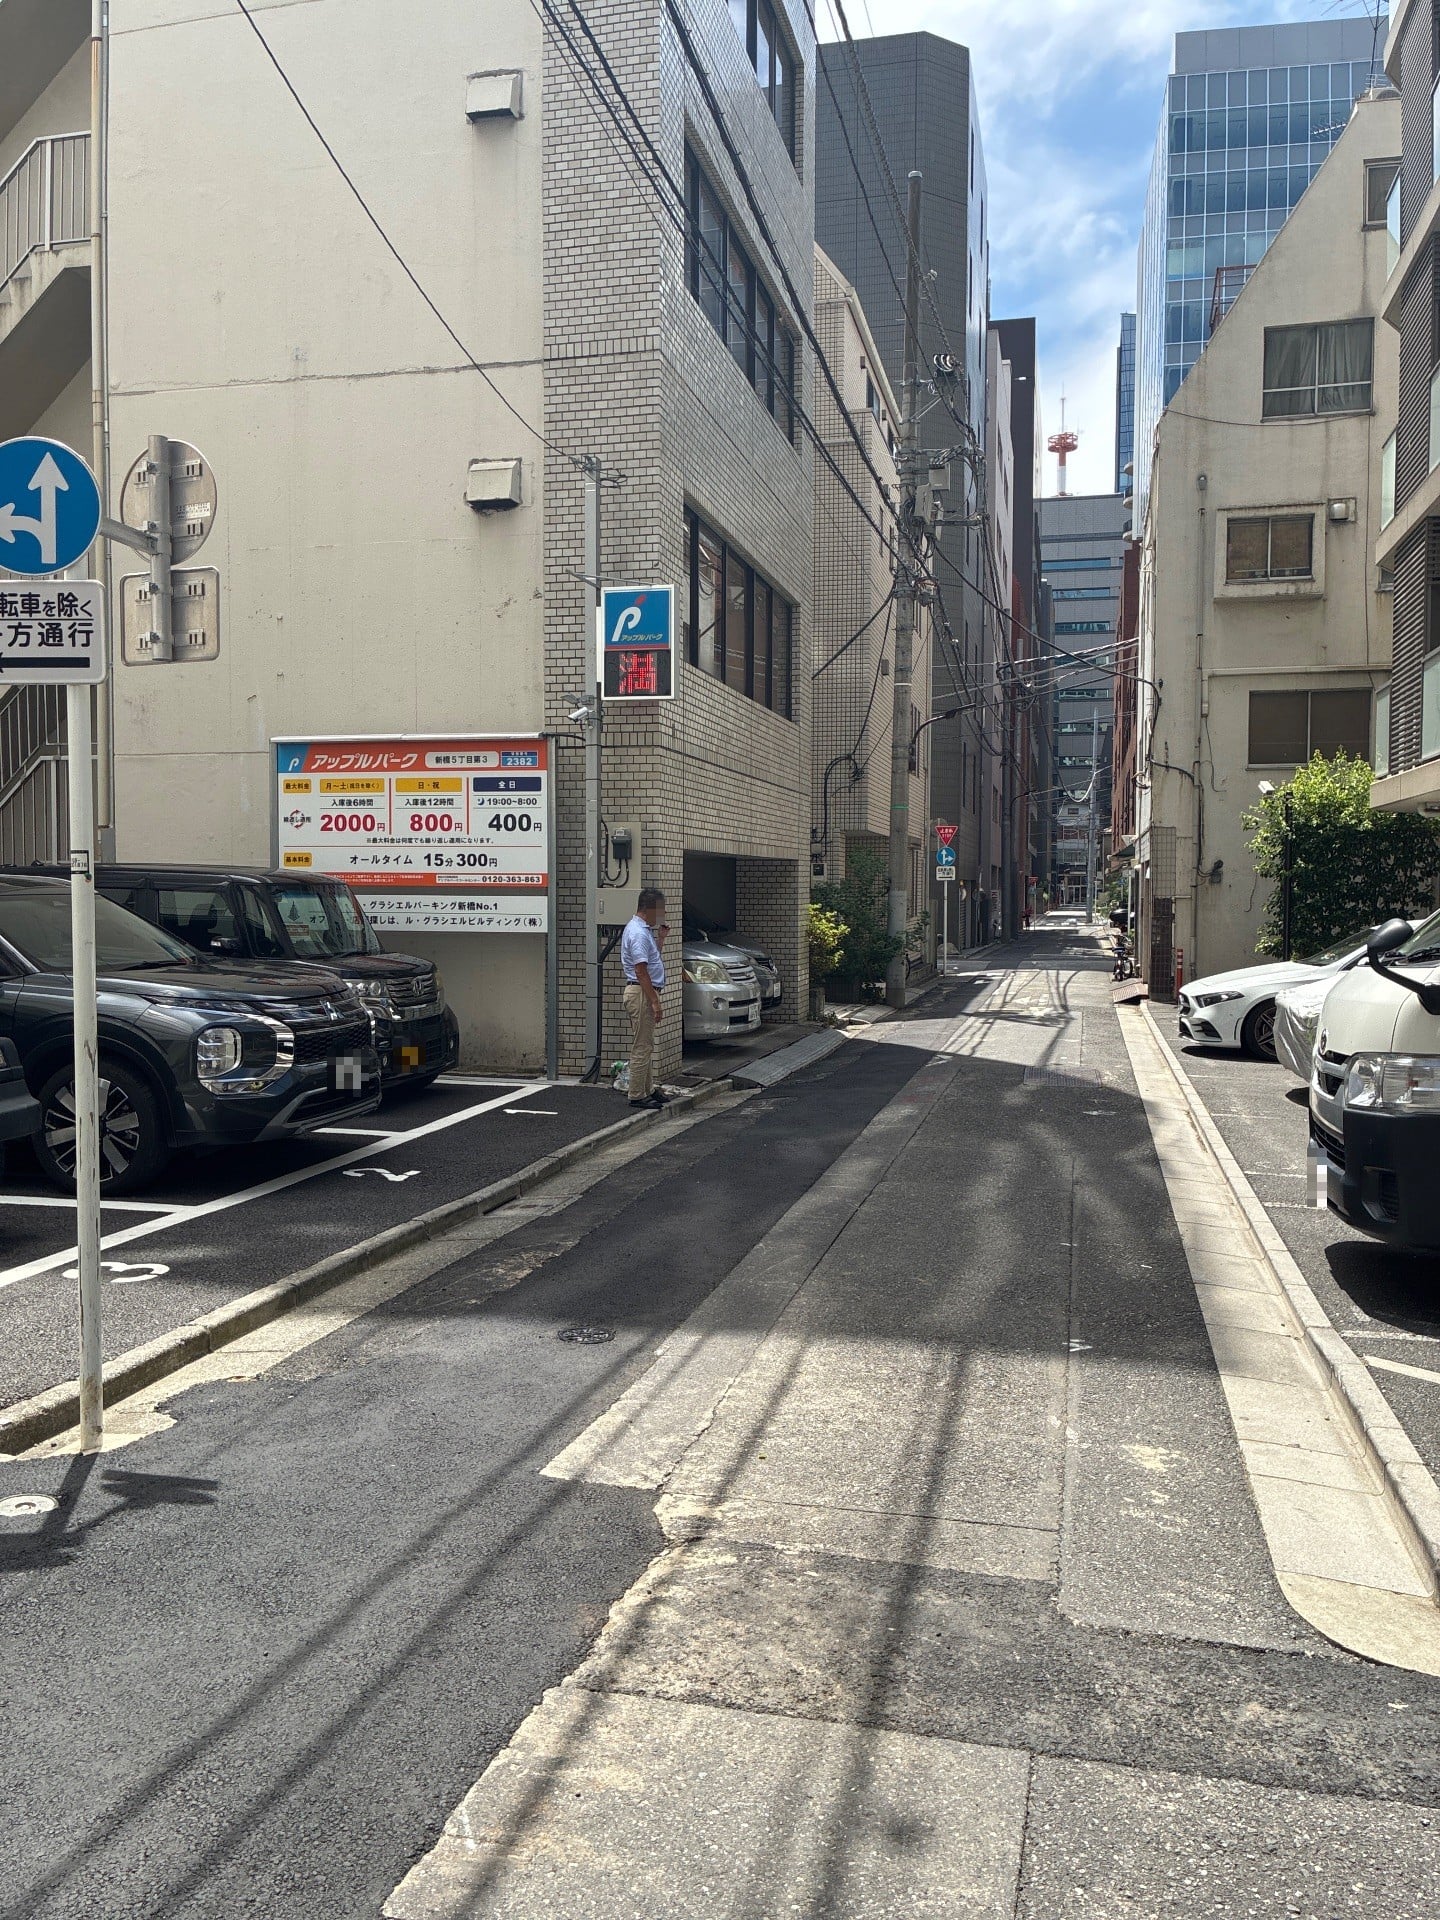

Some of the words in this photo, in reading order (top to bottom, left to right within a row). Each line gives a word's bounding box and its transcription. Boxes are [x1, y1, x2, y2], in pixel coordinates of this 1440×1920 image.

[0, 622, 94, 647] 方通行
[619, 653, 657, 694] 満
[310, 752, 418, 769] アップルパーク
[506, 757, 533, 766] 2382
[285, 782, 310, 790] 最大料金
[498, 780, 516, 789] 全日
[331, 798, 374, 807] 入庫後6時間
[404, 798, 454, 807] 入庫後12時間
[320, 814, 386, 832] 2000円
[409, 813, 463, 832] 800円
[488, 813, 542, 832] 400円
[350, 854, 413, 865] オールタイム
[482, 875, 541, 884] 0120-363-863
